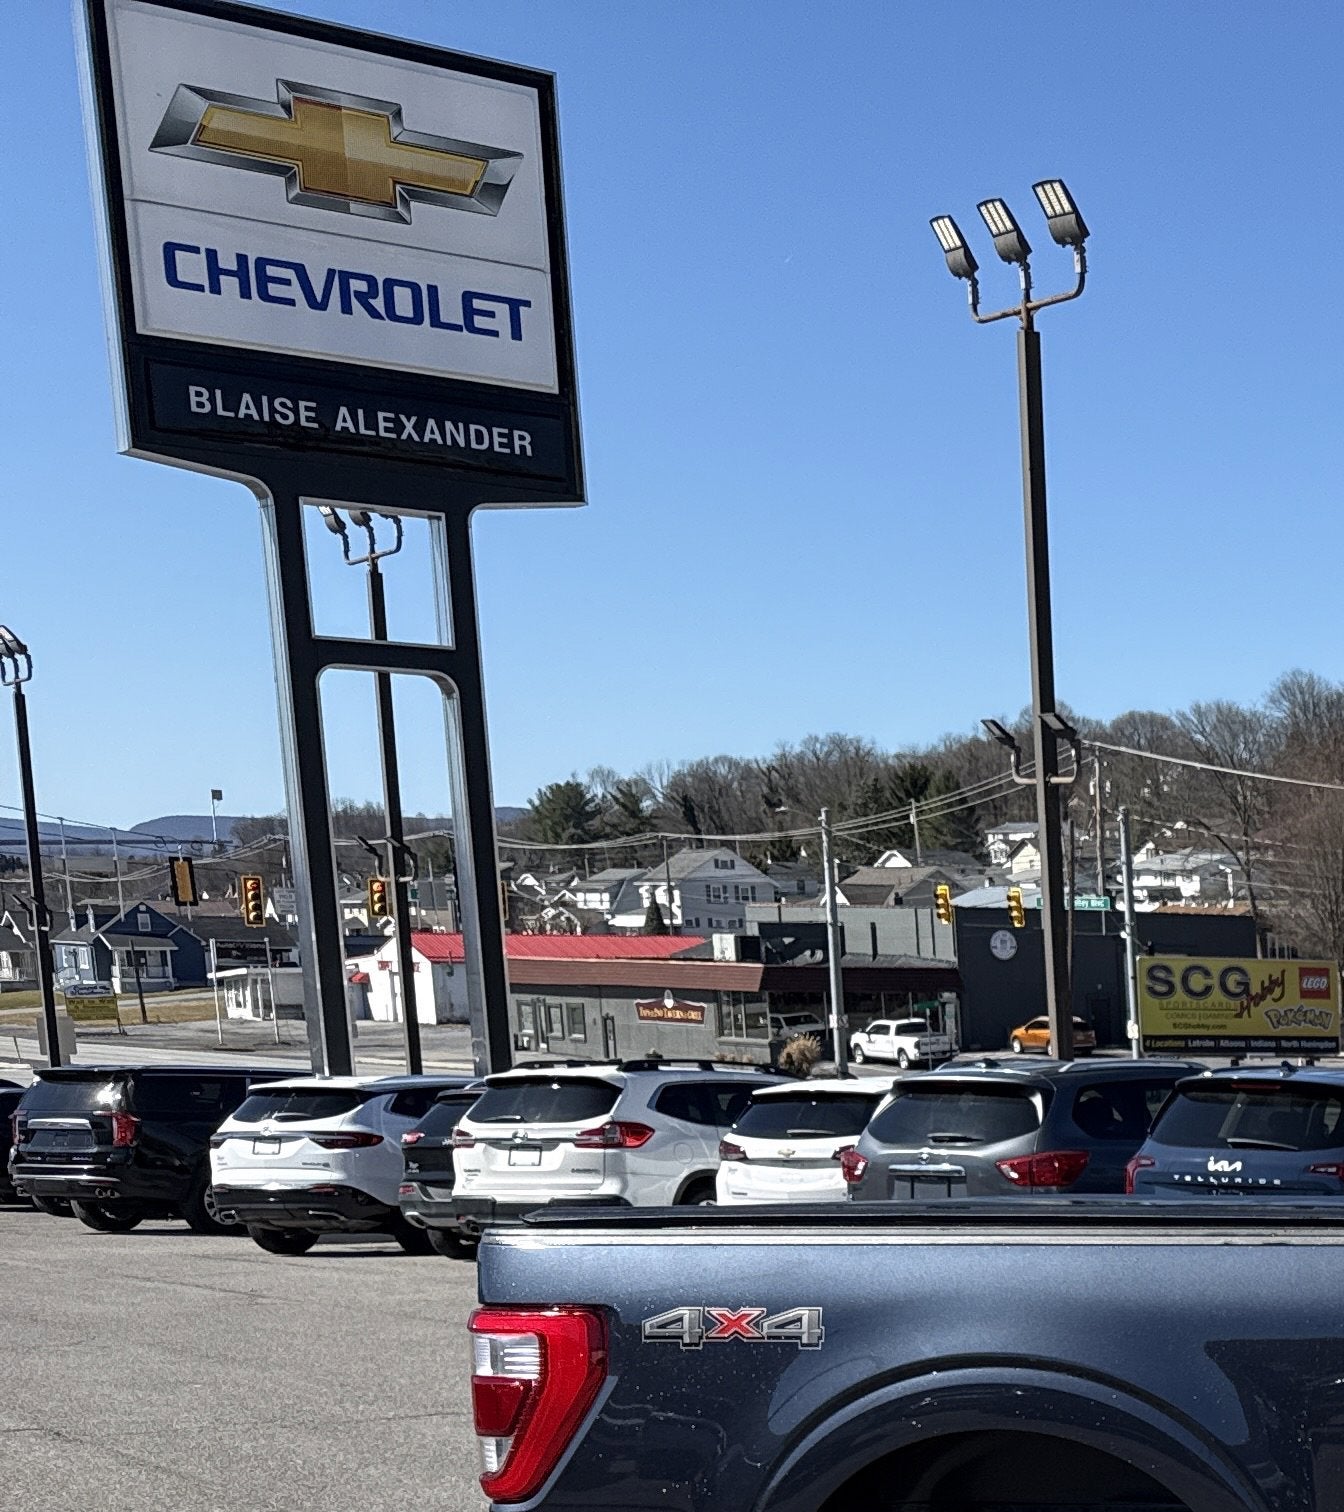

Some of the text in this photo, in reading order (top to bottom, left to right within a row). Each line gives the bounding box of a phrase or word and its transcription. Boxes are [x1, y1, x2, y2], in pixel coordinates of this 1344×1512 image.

[163, 241, 532, 341] CHEVROLET
[188, 385, 533, 457] BLAISE ALEXANDER
[1146, 963, 1286, 1018] SCG Hobby
[1302, 975, 1328, 989] LEGO
[1152, 1039, 1186, 1048] Locations
[1188, 1039, 1215, 1048] Latrobe
[1173, 1174, 1281, 1185] TELLURIDE
